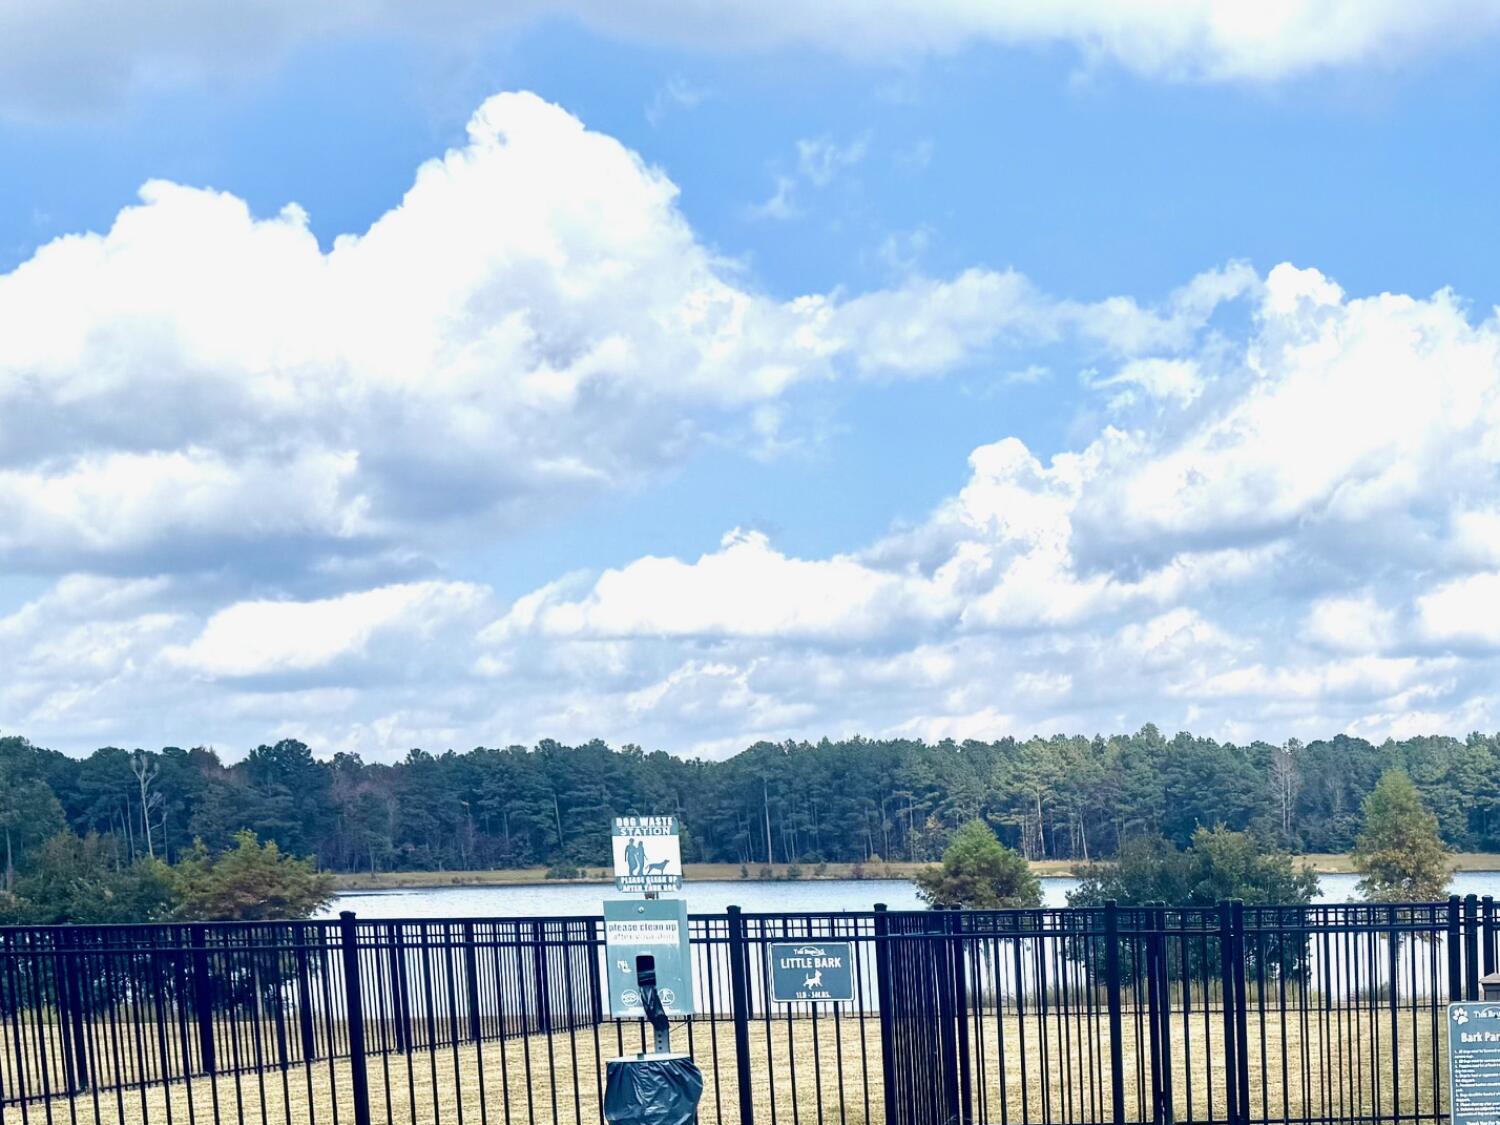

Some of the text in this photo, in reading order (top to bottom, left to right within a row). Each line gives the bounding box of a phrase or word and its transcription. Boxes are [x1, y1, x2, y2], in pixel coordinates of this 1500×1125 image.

[616, 816, 673, 827] DOG WASTE
[620, 827, 671, 836] STATION
[620, 876, 645, 884] PLEASE
[609, 923, 677, 932] please clean up
[780, 957, 841, 969] LITTLE BARK
[1460, 1032, 1482, 1043] Bark
